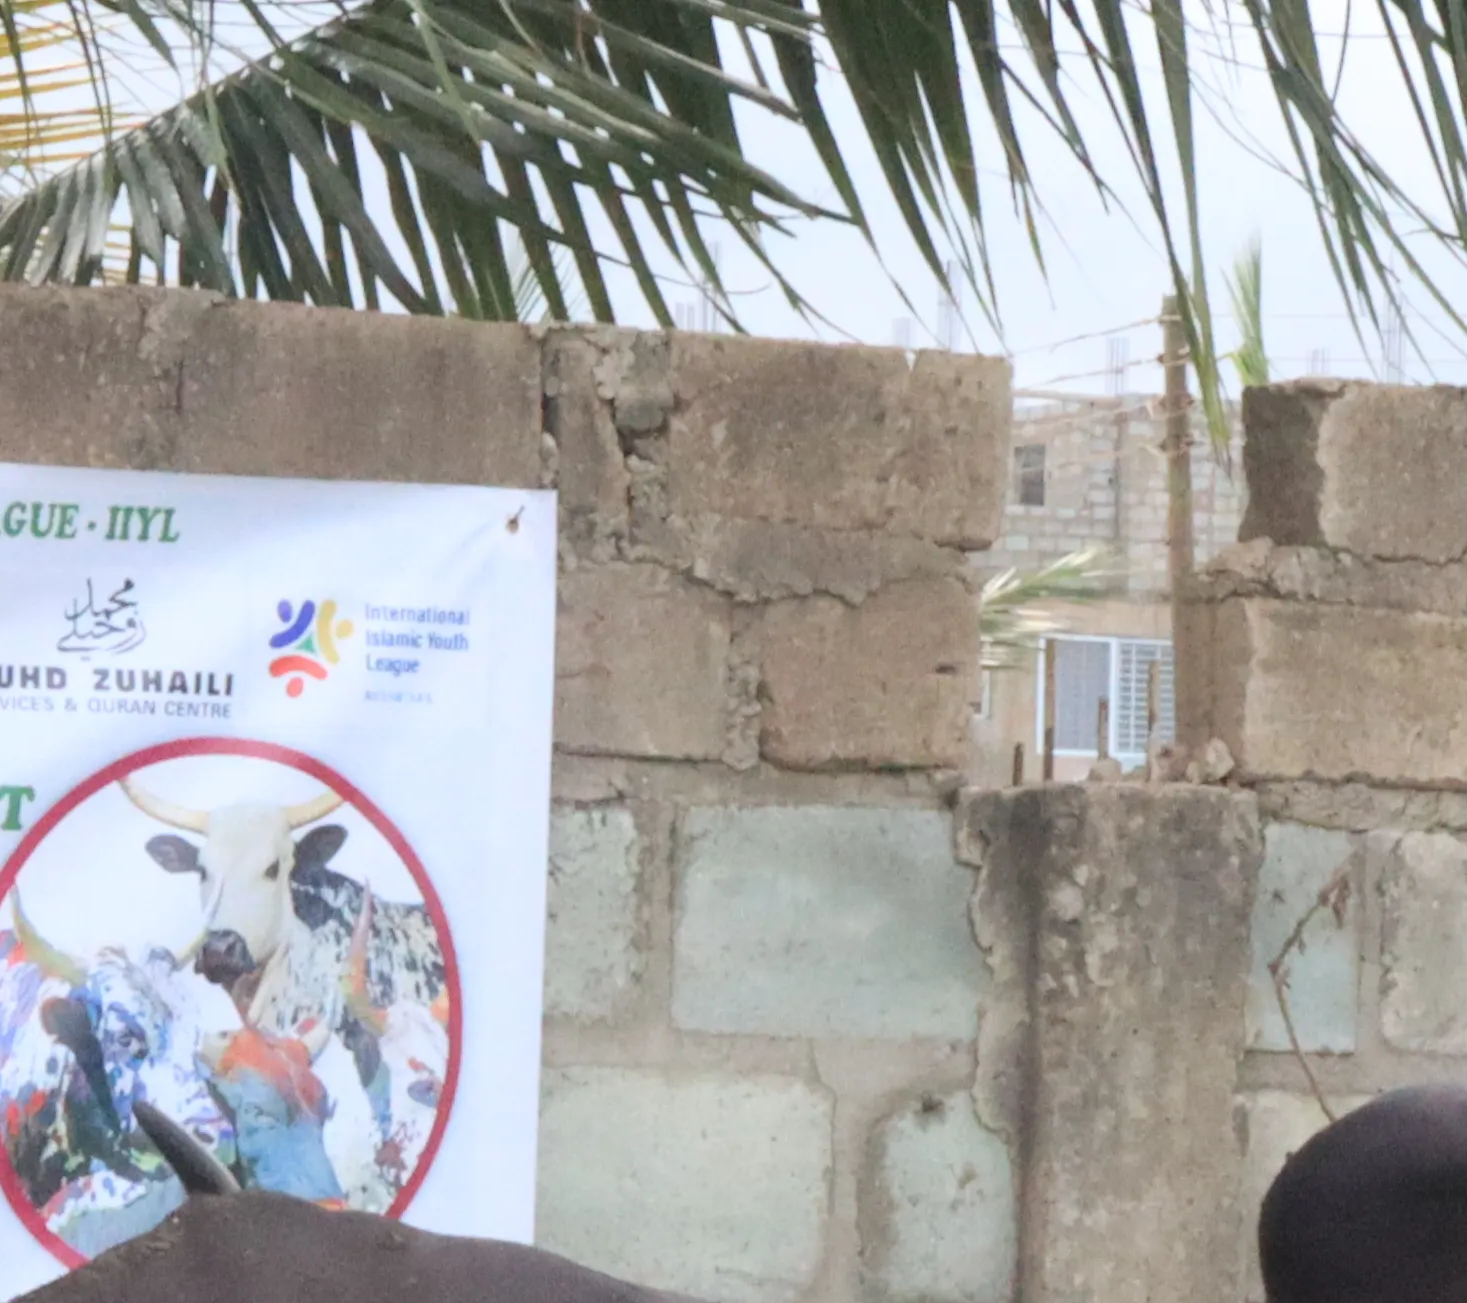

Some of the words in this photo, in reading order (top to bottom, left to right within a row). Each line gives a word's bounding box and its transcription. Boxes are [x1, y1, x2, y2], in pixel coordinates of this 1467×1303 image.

[104, 505, 181, 543] IIYL
[364, 604, 471, 626] International
[364, 629, 423, 650] Islamic
[427, 631, 469, 652] Youth
[365, 653, 421, 677] League
[91, 668, 235, 697] ZUHAILI
[63, 697, 78, 713] &
[87, 697, 156, 716] QURAN
[163, 700, 232, 719] CENTRE
